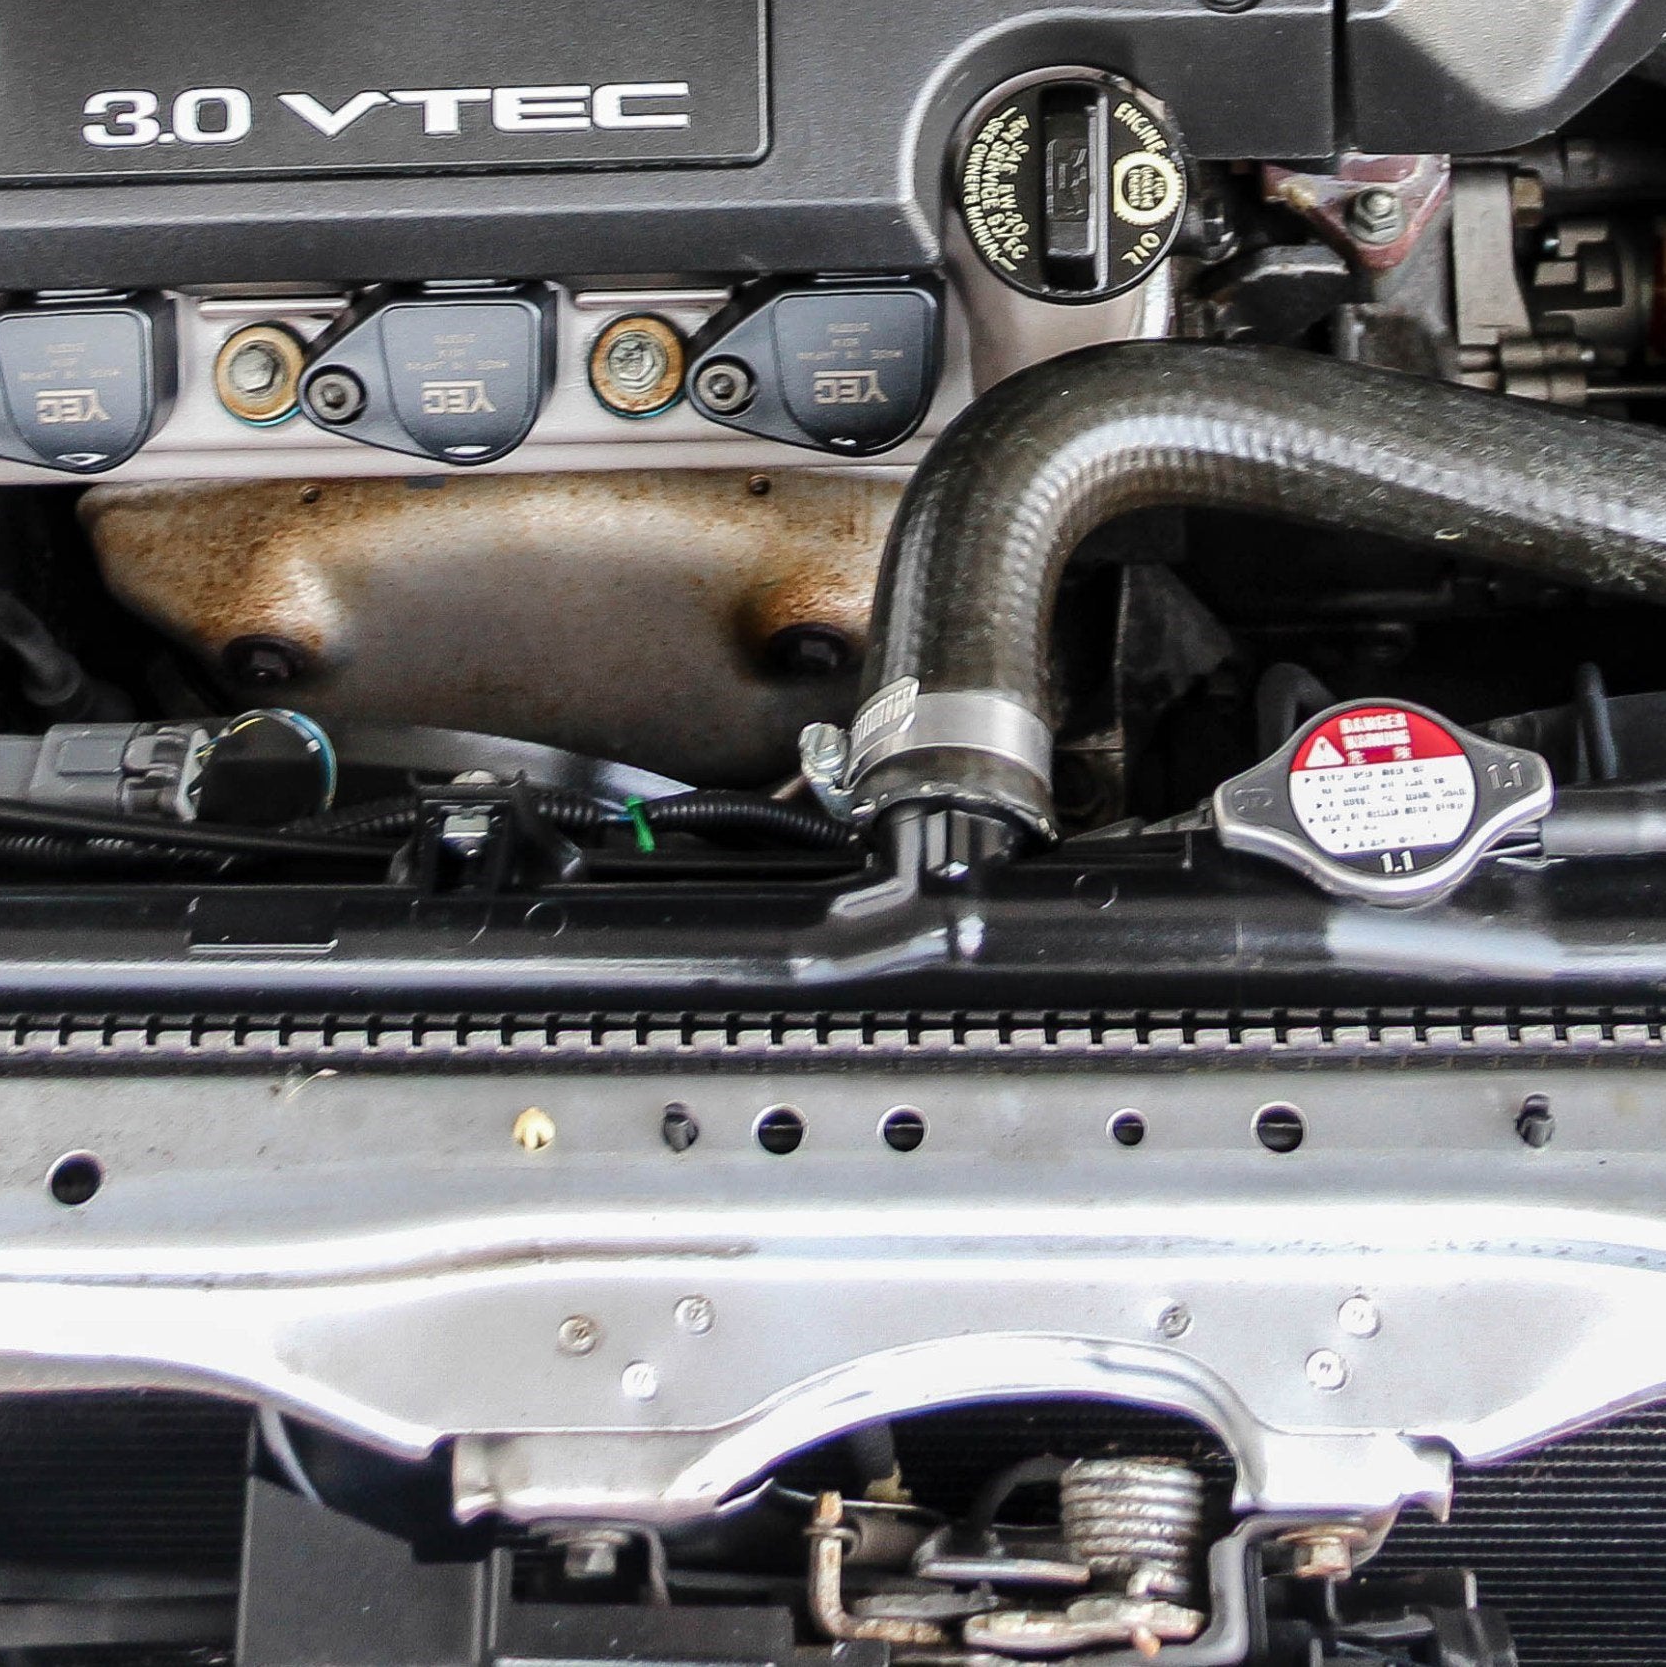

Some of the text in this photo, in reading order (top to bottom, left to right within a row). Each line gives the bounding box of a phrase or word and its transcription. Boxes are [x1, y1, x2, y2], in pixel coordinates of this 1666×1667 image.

[82, 81, 692, 148] 3.0 VTEC
[1113, 101, 1168, 153] ENGINE
[963, 143, 989, 205] OWNER'S
[980, 140, 1011, 210] SERVICE
[1121, 232, 1161, 265] OIL
[421, 379, 497, 415] YEC
[813, 370, 889, 405] YEC
[35, 387, 112, 426] YEC
[1486, 761, 1525, 788] 1.1
[1380, 849, 1416, 874] 1.1
